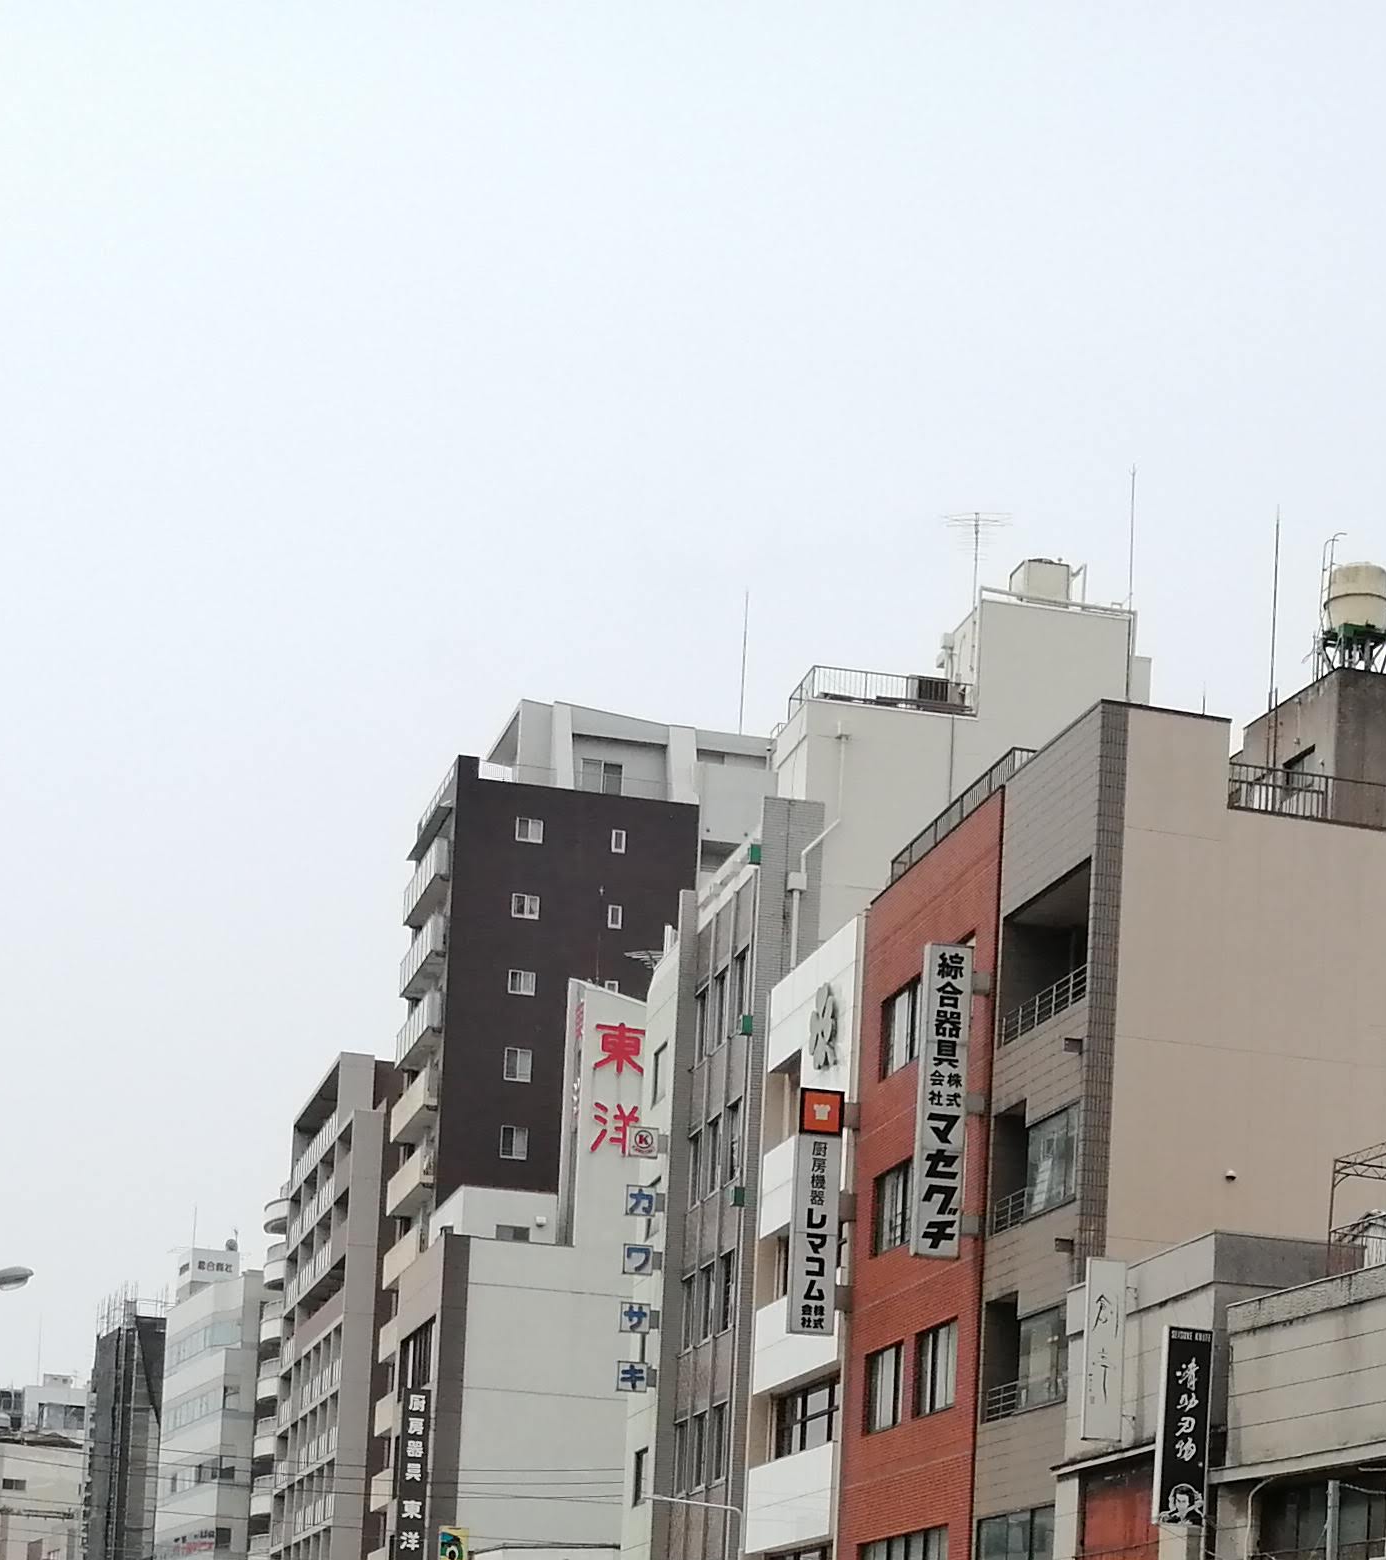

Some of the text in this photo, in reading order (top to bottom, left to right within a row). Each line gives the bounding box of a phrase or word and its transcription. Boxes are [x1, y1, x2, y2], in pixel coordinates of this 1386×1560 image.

[932, 952, 965, 1069] 綜合器具
[590, 1022, 646, 1158] 東洋
[920, 1111, 960, 1251] マセグチ
[619, 1188, 654, 1391] カワサキ
[802, 1207, 832, 1302] レマコム
[405, 1394, 426, 1482] 厨房器具
